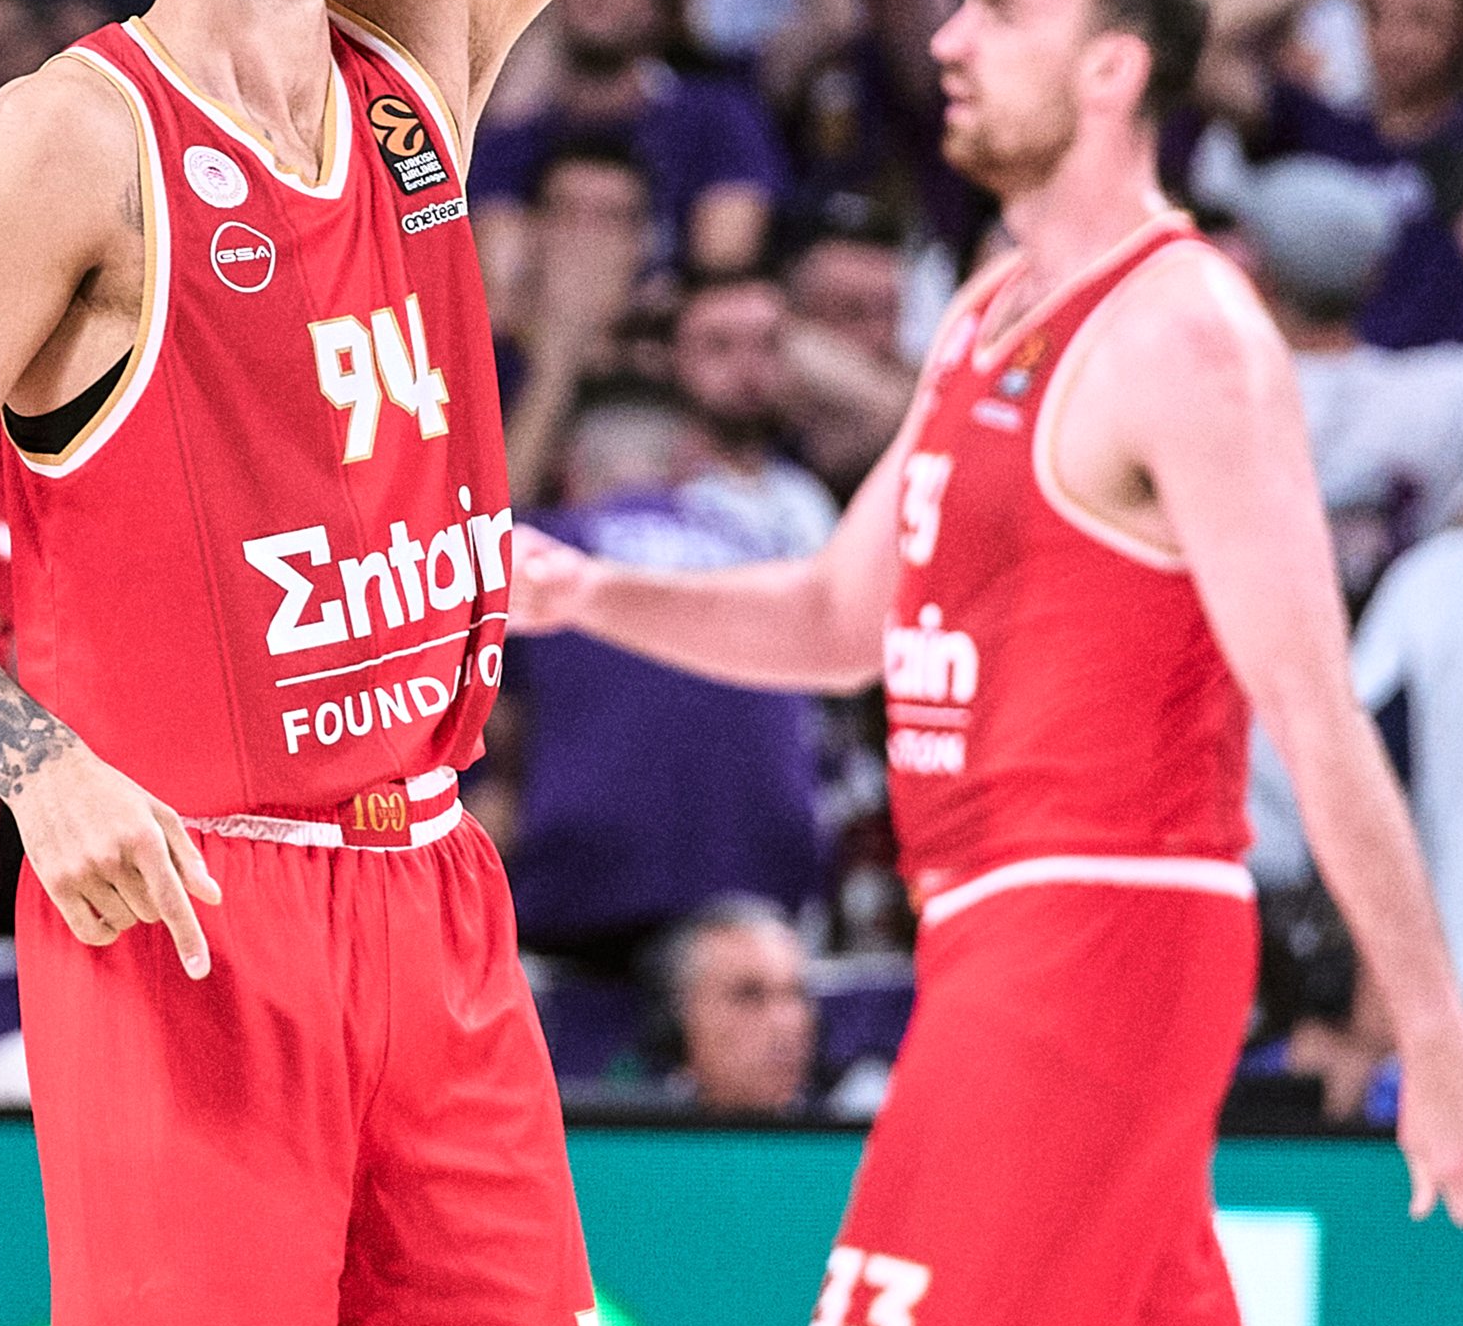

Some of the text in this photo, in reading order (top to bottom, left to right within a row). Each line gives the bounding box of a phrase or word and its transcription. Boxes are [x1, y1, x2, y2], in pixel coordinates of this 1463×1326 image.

[393, 150, 438, 173] TURKISH
[400, 160, 443, 183] AIRLINES
[216, 244, 271, 264] GSA
[309, 293, 450, 465] 94
[352, 792, 406, 832] 100
